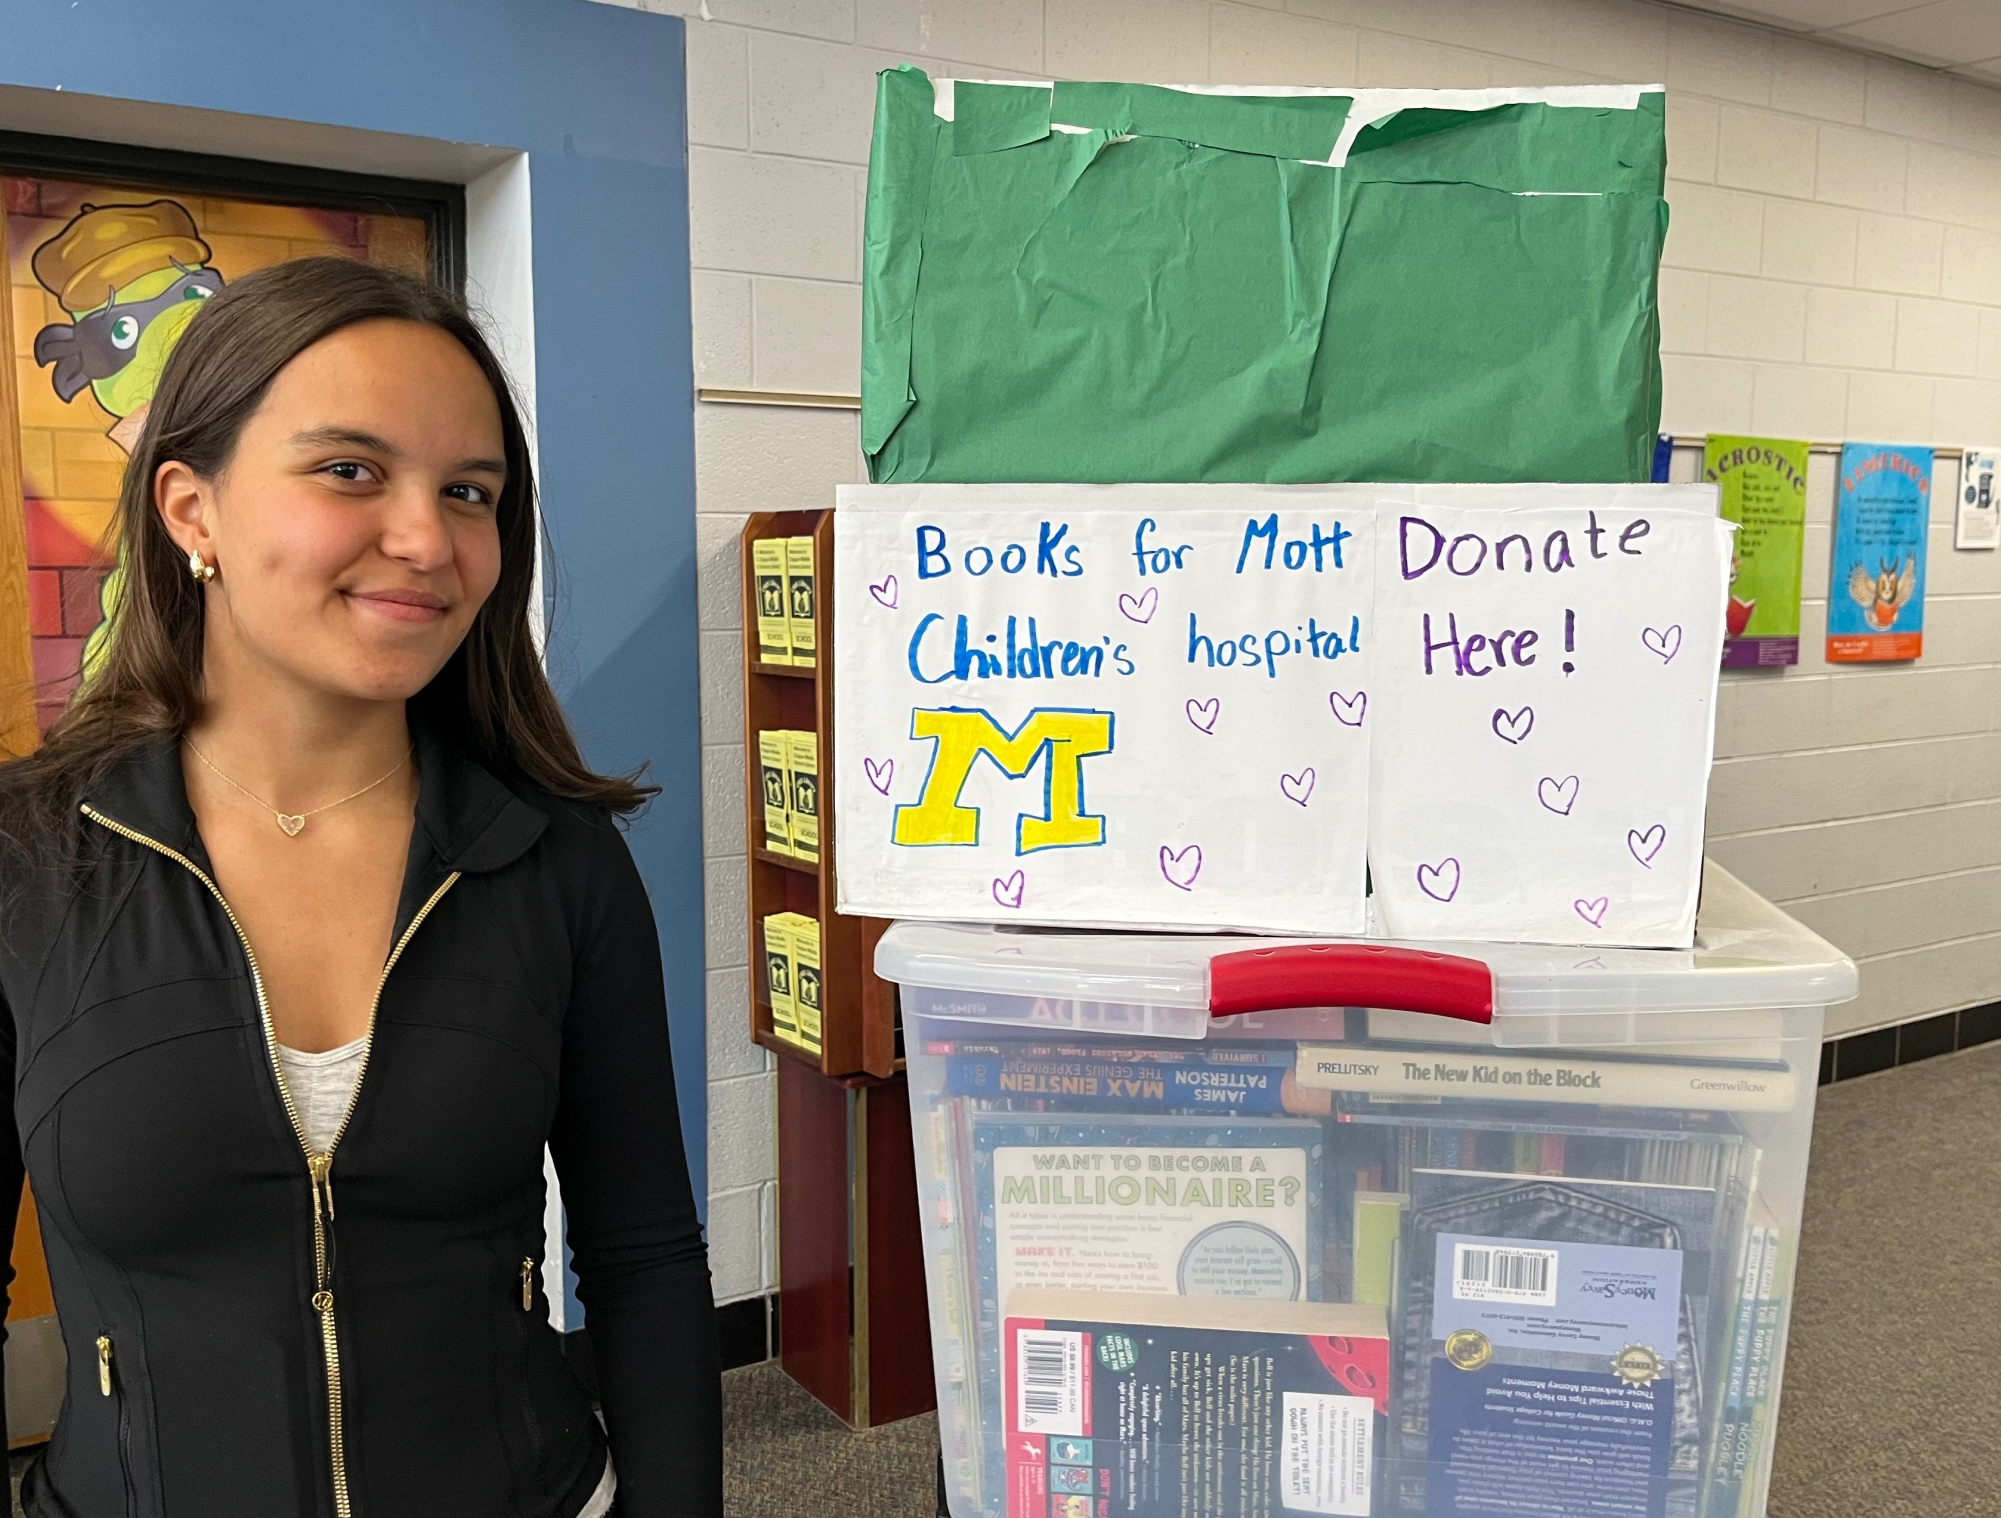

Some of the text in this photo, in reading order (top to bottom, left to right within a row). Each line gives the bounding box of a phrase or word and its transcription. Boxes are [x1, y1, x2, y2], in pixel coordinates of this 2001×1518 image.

[916, 514, 1352, 579] Books for Mott
[1400, 511, 1651, 580] Donate
[908, 613, 1361, 683] Children's hospital
[891, 706, 1115, 856] M
[932, 1003, 987, 1014] McSMITH
[1211, 1053, 1260, 1063] SURVIVED
[1002, 1061, 1161, 1079] THE GENIUS EXPERIMENT
[1317, 1062, 1767, 1095] PRELUTSKY The New Kid on the Block Greenwillow
[1000, 1073, 1163, 1099] MAX EINSTEIN
[1175, 1071, 1266, 1088] PATTERSON
[1194, 1089, 1246, 1102] JAMES
[1032, 1154, 1266, 1172] WANT TO BECOME A
[1001, 1175, 1301, 1207] MILLIONAIRE?
[1070, 1343, 1075, 1351] US
[1106, 1336, 1116, 1351] FACTS
[1115, 1336, 1123, 1350] COOL
[1123, 1338, 1134, 1363] INCLUDES
[1751, 1329, 1765, 1362] PUPPY
[1503, 1378, 1654, 1399] Those Awkward Money Moments
[1746, 1367, 1759, 1397] PLACE
[1487, 1388, 1513, 1397] Avoid
[1515, 1391, 1531, 1400] You
[1534, 1391, 1554, 1402] Help
[1569, 1395, 1587, 1404] Tips
[1590, 1397, 1629, 1409] Essential
[1632, 1401, 1654, 1410] With
[1290, 1408, 1298, 1430] DOWN
[1290, 1434, 1298, 1443] ON
[1291, 1447, 1300, 1462] THE
[1300, 1408, 1310, 1495] ALWAYS PUT THE SEAT
[1733, 1422, 1749, 1478] NOODLE
